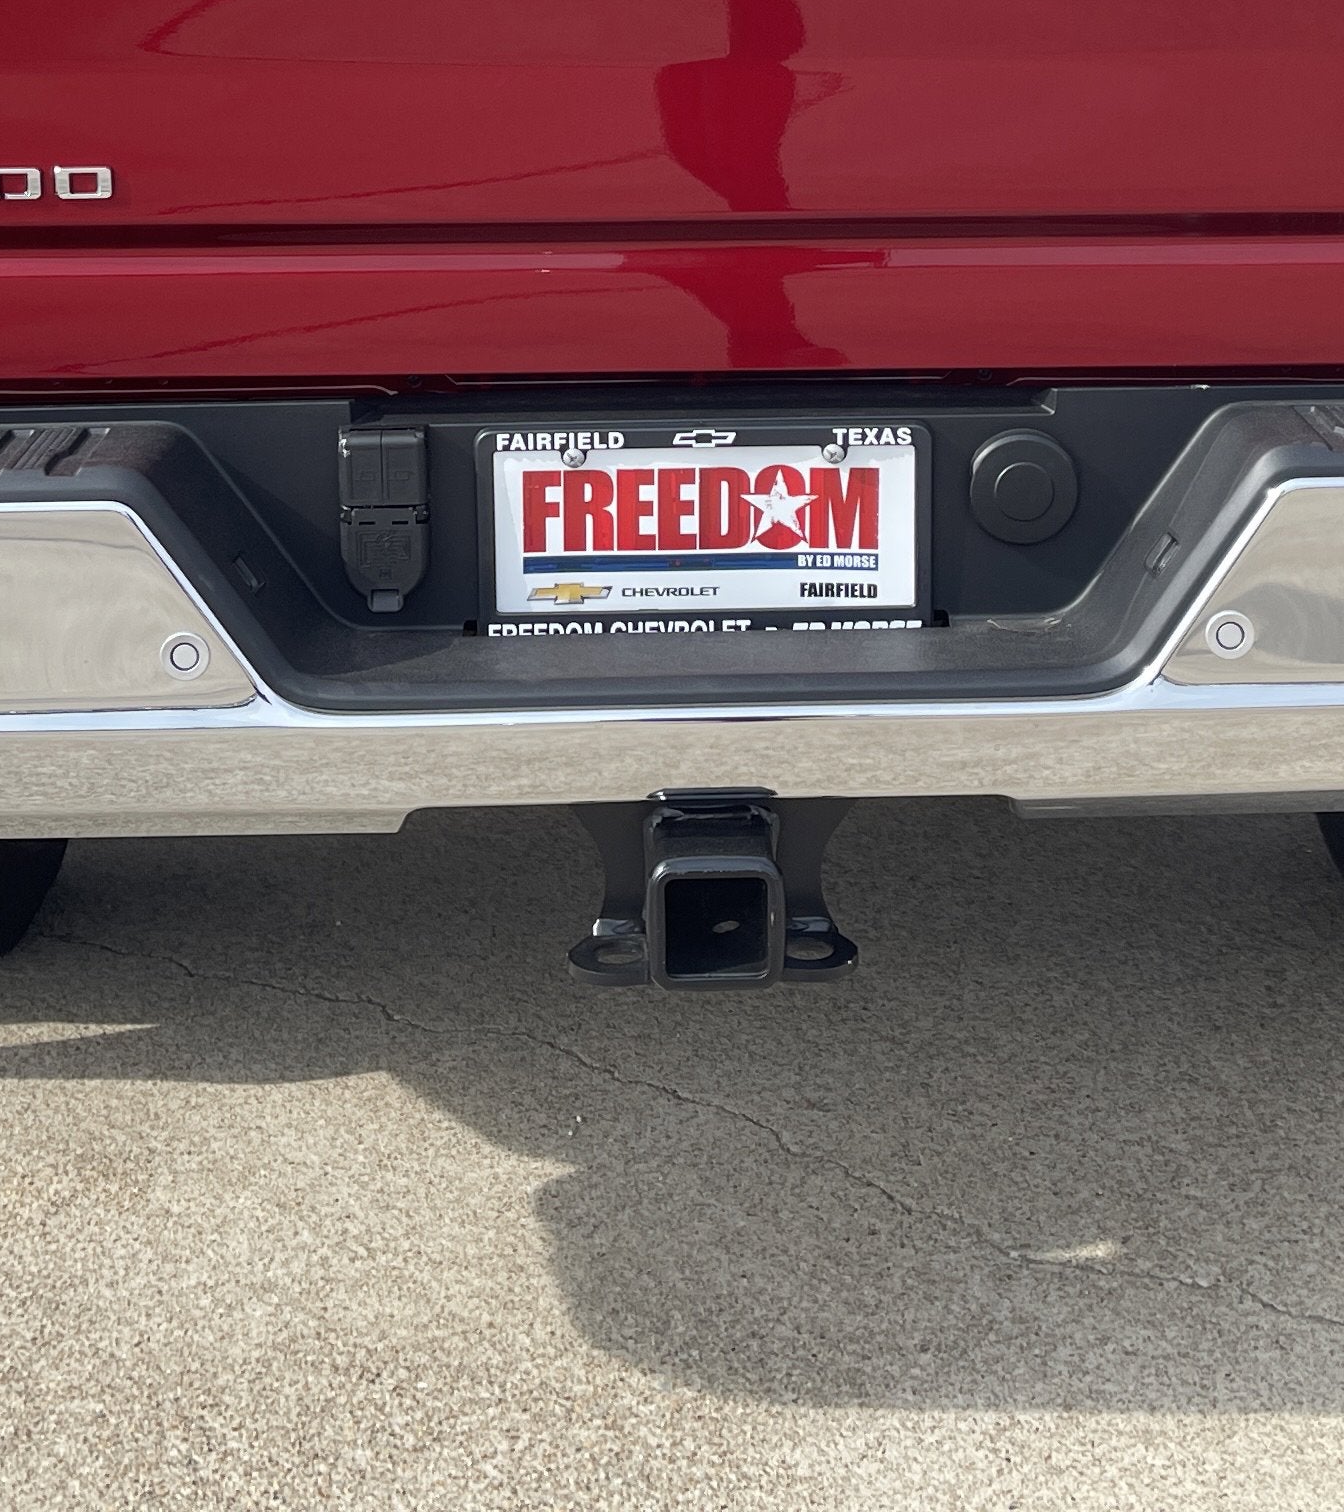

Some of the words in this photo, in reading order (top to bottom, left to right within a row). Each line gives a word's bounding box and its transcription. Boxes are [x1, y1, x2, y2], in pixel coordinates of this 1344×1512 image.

[496, 431, 625, 451] FAIRFIELD
[833, 427, 913, 446] TEXAS
[522, 464, 880, 553] FREEDOM
[797, 554, 813, 568] BY
[816, 554, 831, 568] ED
[833, 554, 877, 569] MORSE
[621, 585, 720, 598] CHEVROLET
[799, 582, 878, 599] FAIRFIELD
